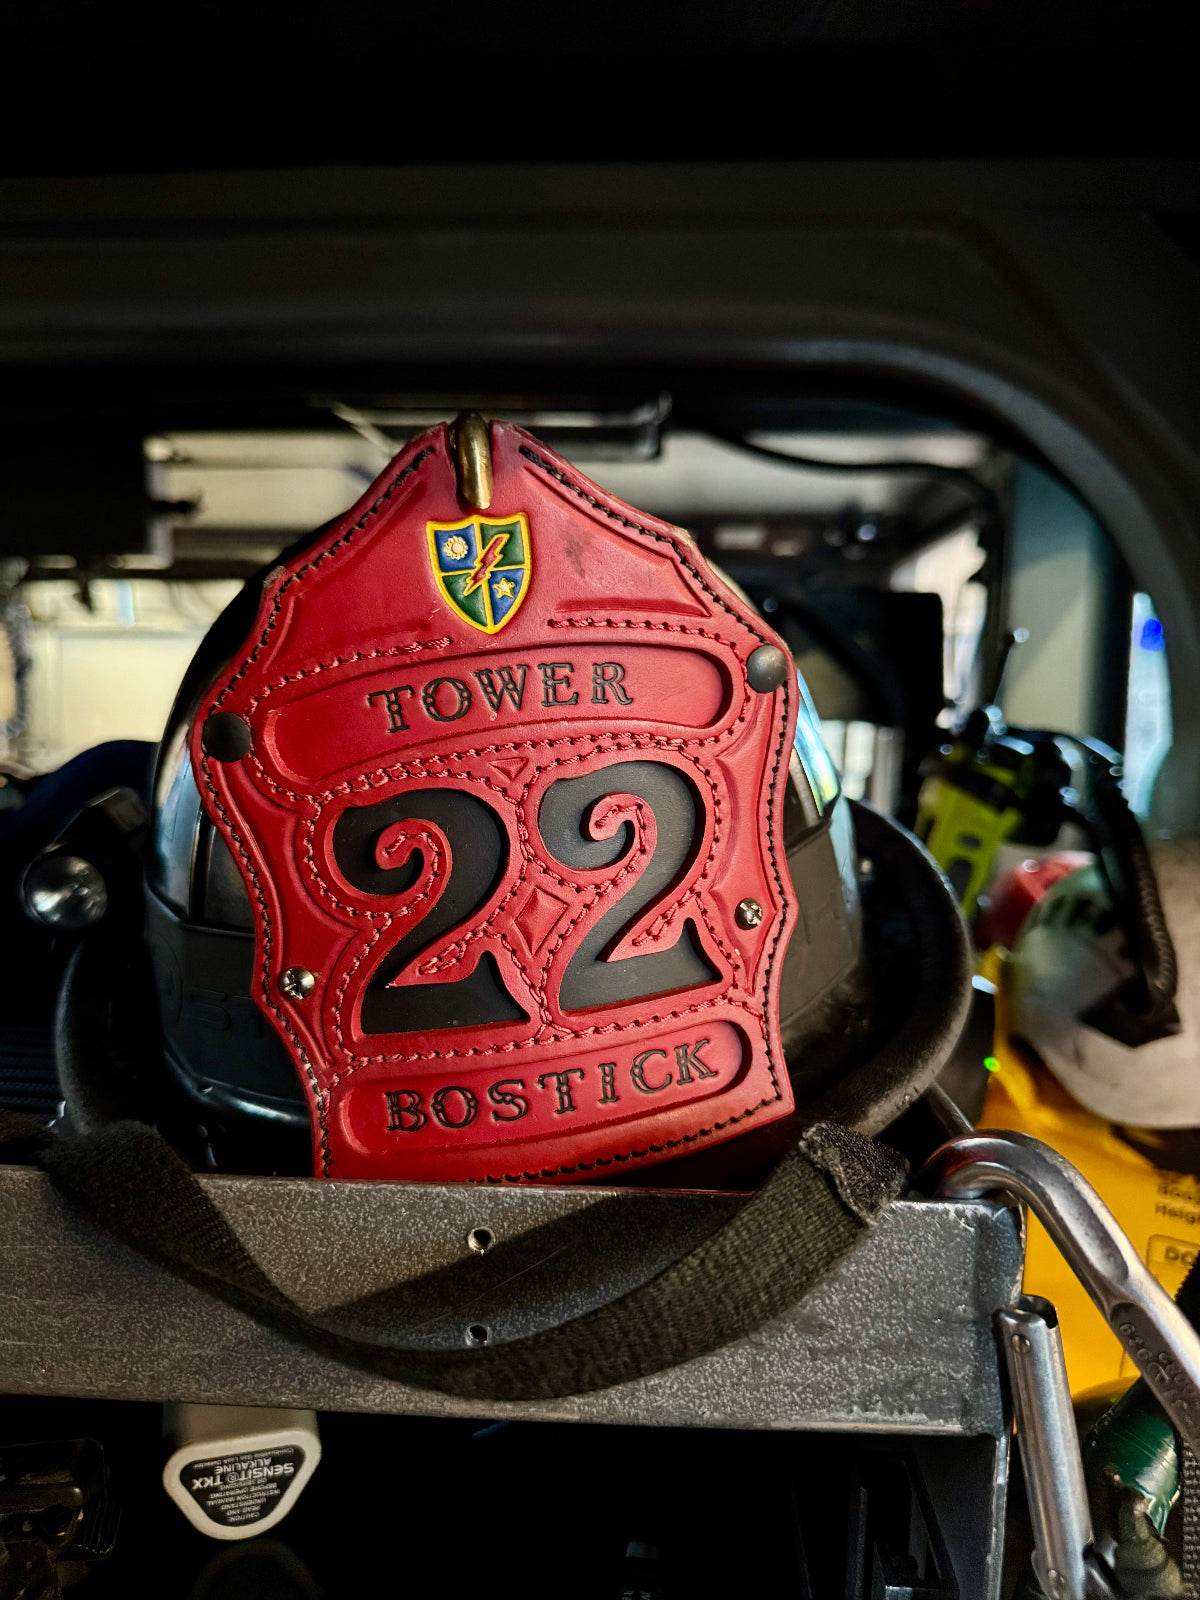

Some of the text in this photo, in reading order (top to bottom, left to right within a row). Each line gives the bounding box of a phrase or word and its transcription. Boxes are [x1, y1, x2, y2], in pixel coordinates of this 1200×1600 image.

[367, 661, 633, 734] TOWER
[332, 760, 723, 1035] 22
[385, 1039, 718, 1131] BOSTICK
[192, 1474, 224, 1490] TKX
[215, 1457, 272, 1474] ALKALINE
